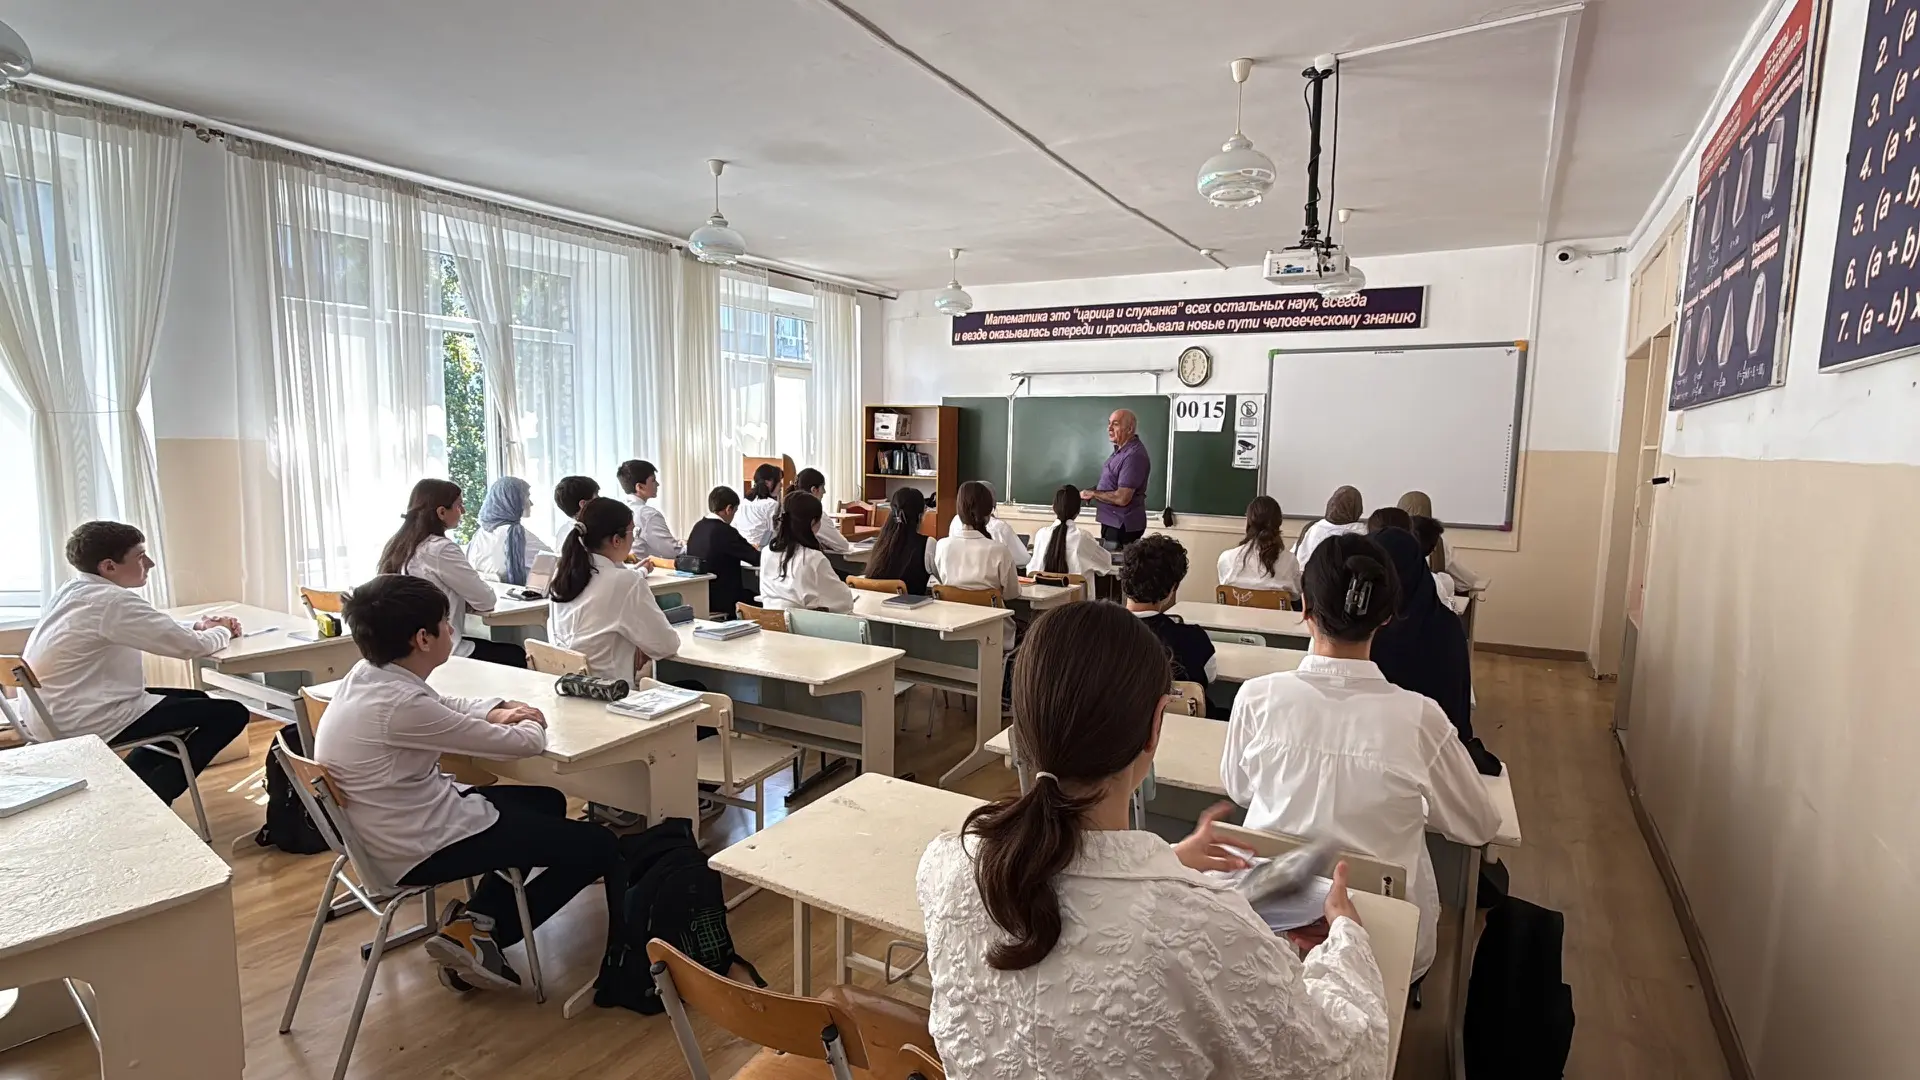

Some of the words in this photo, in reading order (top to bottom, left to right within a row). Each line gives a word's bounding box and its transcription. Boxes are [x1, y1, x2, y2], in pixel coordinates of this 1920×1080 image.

[1874, 36, 1888, 74] 2.
[1867, 93, 1880, 128] 3.
[1859, 147, 1873, 181] 4.
[1852, 203, 1865, 236] 5.
[1845, 258, 1857, 290] 6.
[954, 333, 960, 341] и
[961, 329, 987, 341] везде
[989, 328, 1050, 340] оказывалась
[1052, 323, 1094, 339] впереди
[1096, 325, 1103, 335] и
[1105, 319, 1184, 336] прокладывала
[1187, 318, 1225, 331] новые
[1227, 316, 1260, 332] пути
[1263, 313, 1361, 329] человеческому
[1363, 311, 1416, 325] знанию
[984, 313, 1048, 326] Математика
[1049, 310, 1070, 321] это
[1117, 308, 1124, 318] и
[1185, 302, 1210, 315] всех
[1213, 299, 1284, 313] остальных
[1287, 297, 1319, 312] наук,
[1322, 293, 1367, 308] всегда
[1837, 311, 1850, 342] 7.
